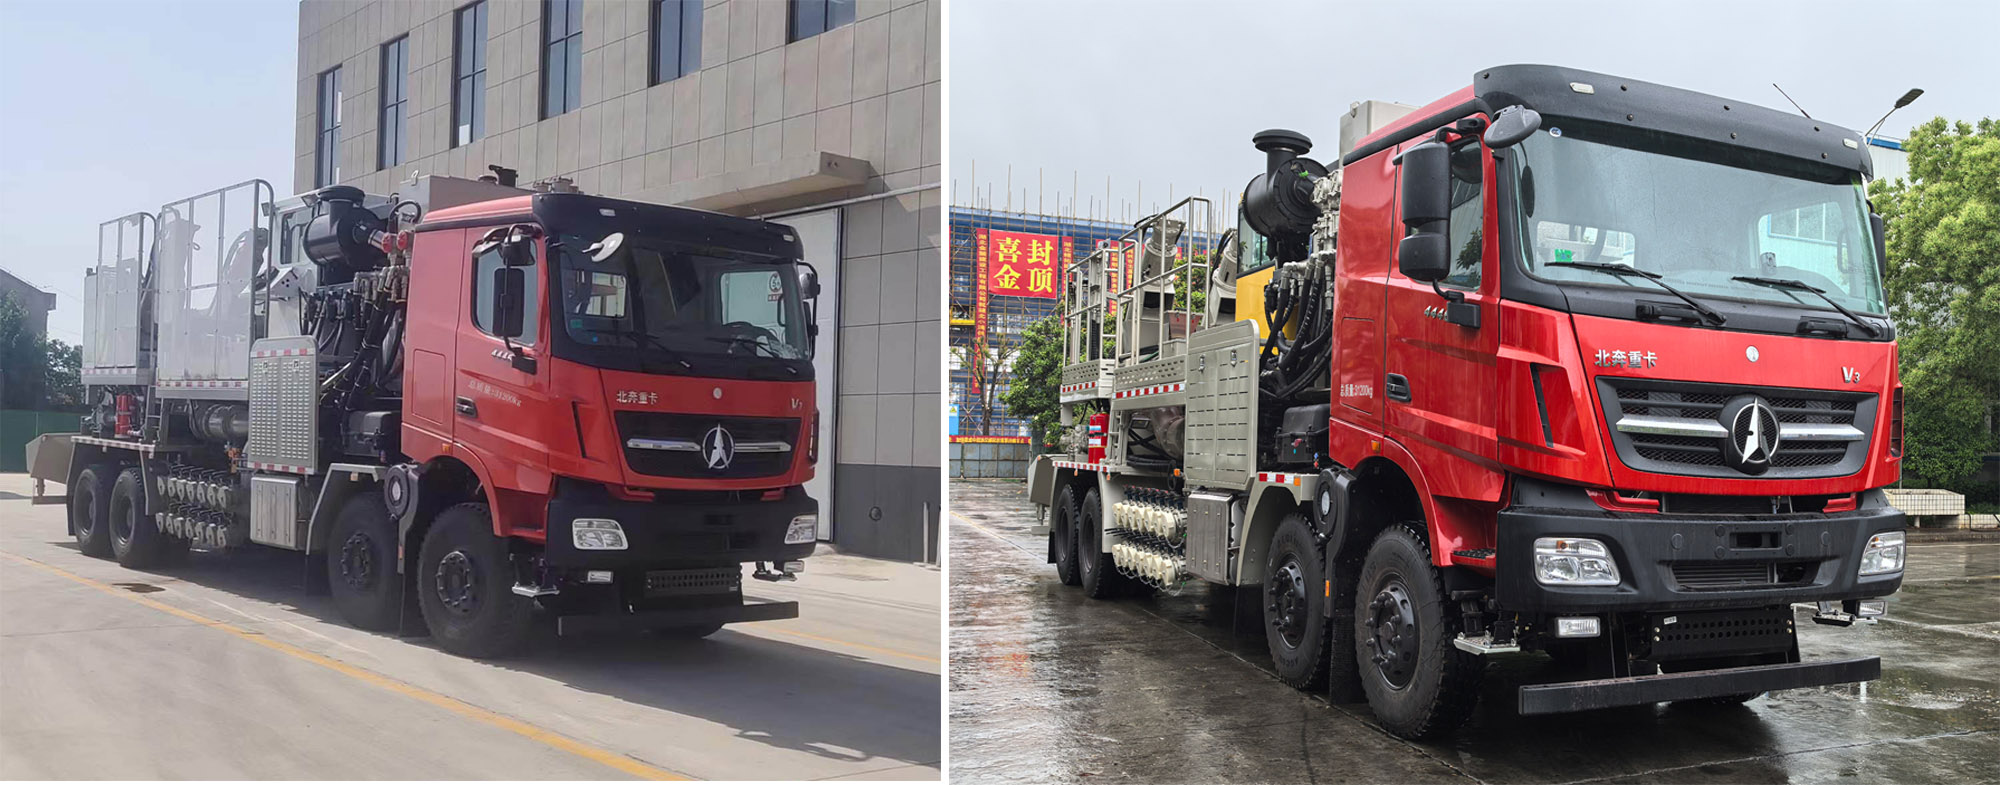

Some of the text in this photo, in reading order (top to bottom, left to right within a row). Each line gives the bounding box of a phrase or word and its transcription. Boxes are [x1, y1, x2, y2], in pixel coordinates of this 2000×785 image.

[1595, 349, 1658, 368] 北奔重卡
[1841, 366, 1860, 383] V3
[616, 390, 658, 404] 北奔重卡
